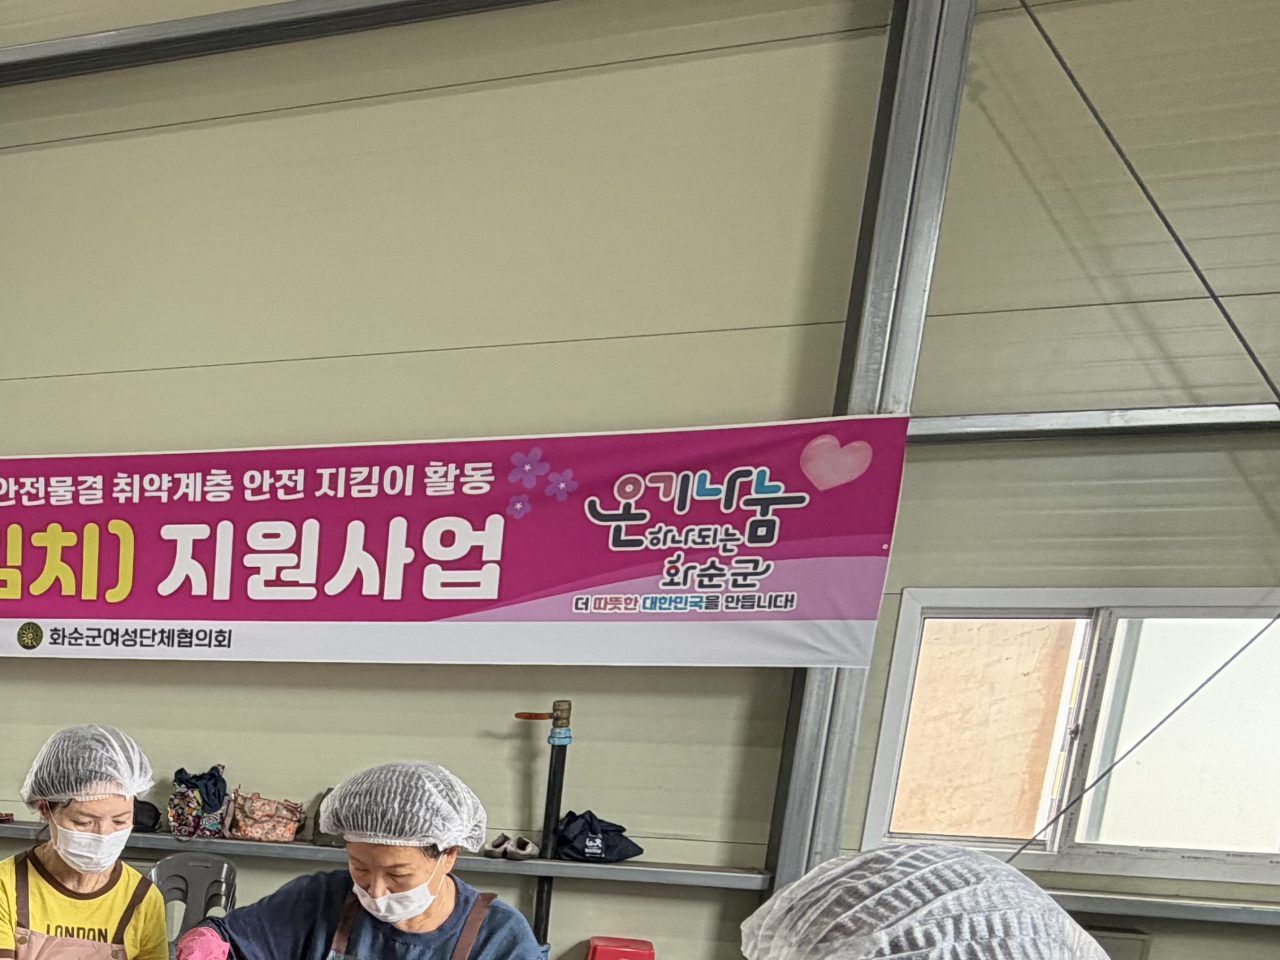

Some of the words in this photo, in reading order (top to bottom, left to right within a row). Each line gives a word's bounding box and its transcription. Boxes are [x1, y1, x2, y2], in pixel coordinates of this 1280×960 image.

[112, 469, 234, 504] 취약계층
[242, 468, 305, 502] 안전
[314, 464, 415, 498] 지킴이
[423, 461, 495, 496] 활동
[585, 466, 810, 550] 온기나눔
[157, 513, 505, 601] 지원사업
[647, 524, 743, 554] 하나되는
[660, 552, 772, 590] 화순군
[574, 597, 588, 611] 더
[593, 596, 639, 611] 따뜻한
[642, 594, 719, 610] 대한민국을
[724, 593, 795, 610] 만듭니다!
[48, 626, 233, 649] 화순군여성단체협의회
